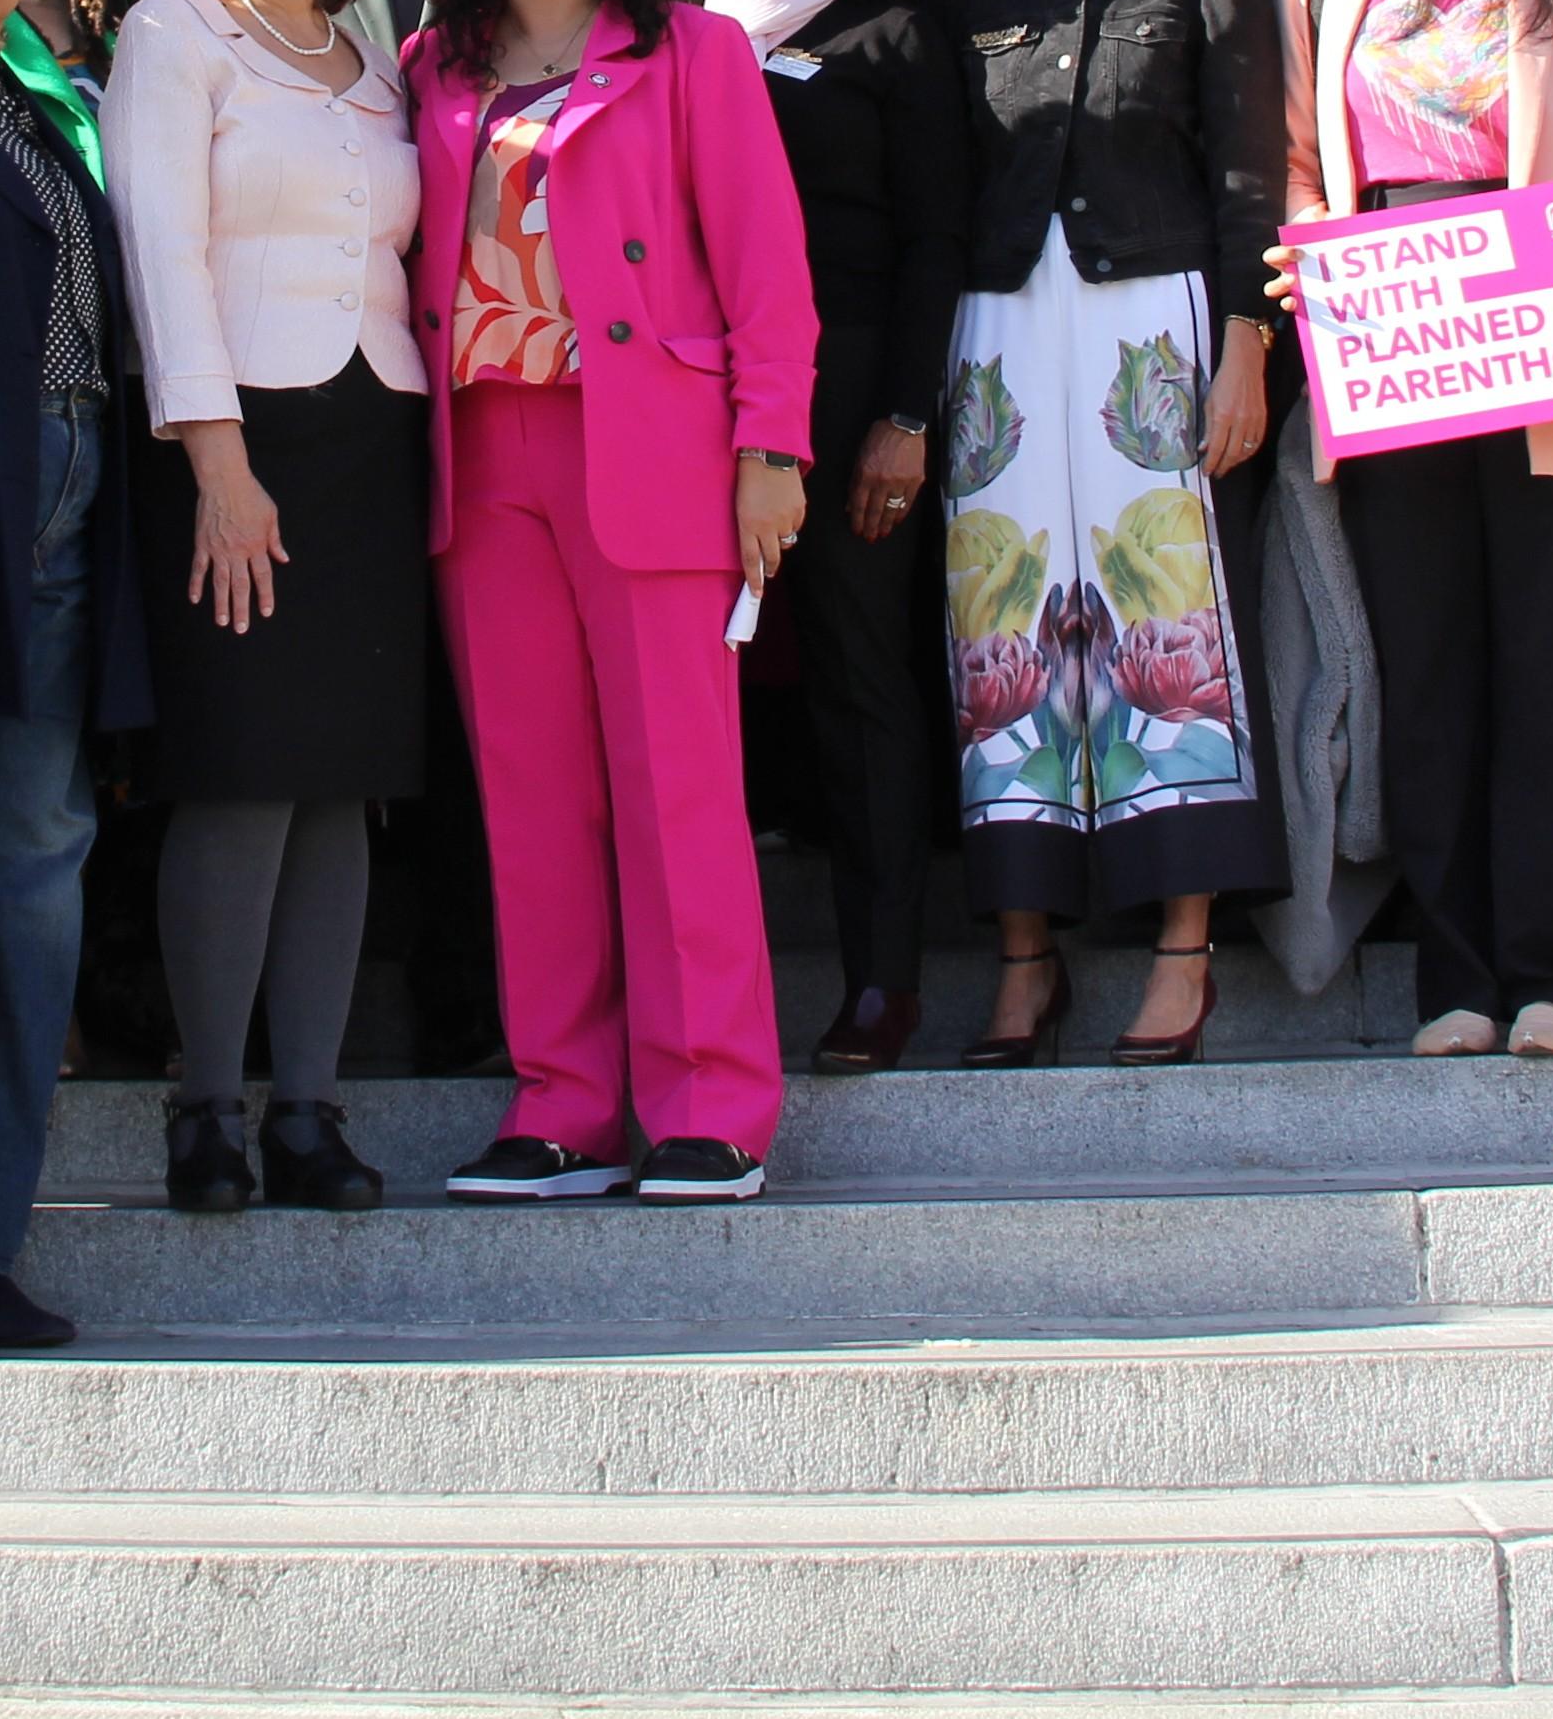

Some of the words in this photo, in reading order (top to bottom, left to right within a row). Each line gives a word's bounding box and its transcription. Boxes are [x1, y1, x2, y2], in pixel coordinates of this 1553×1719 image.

[1317, 251, 1332, 282] I
[1341, 225, 1490, 280] STAND
[1325, 275, 1443, 324] WITH
[1337, 302, 1547, 368] PLANNED
